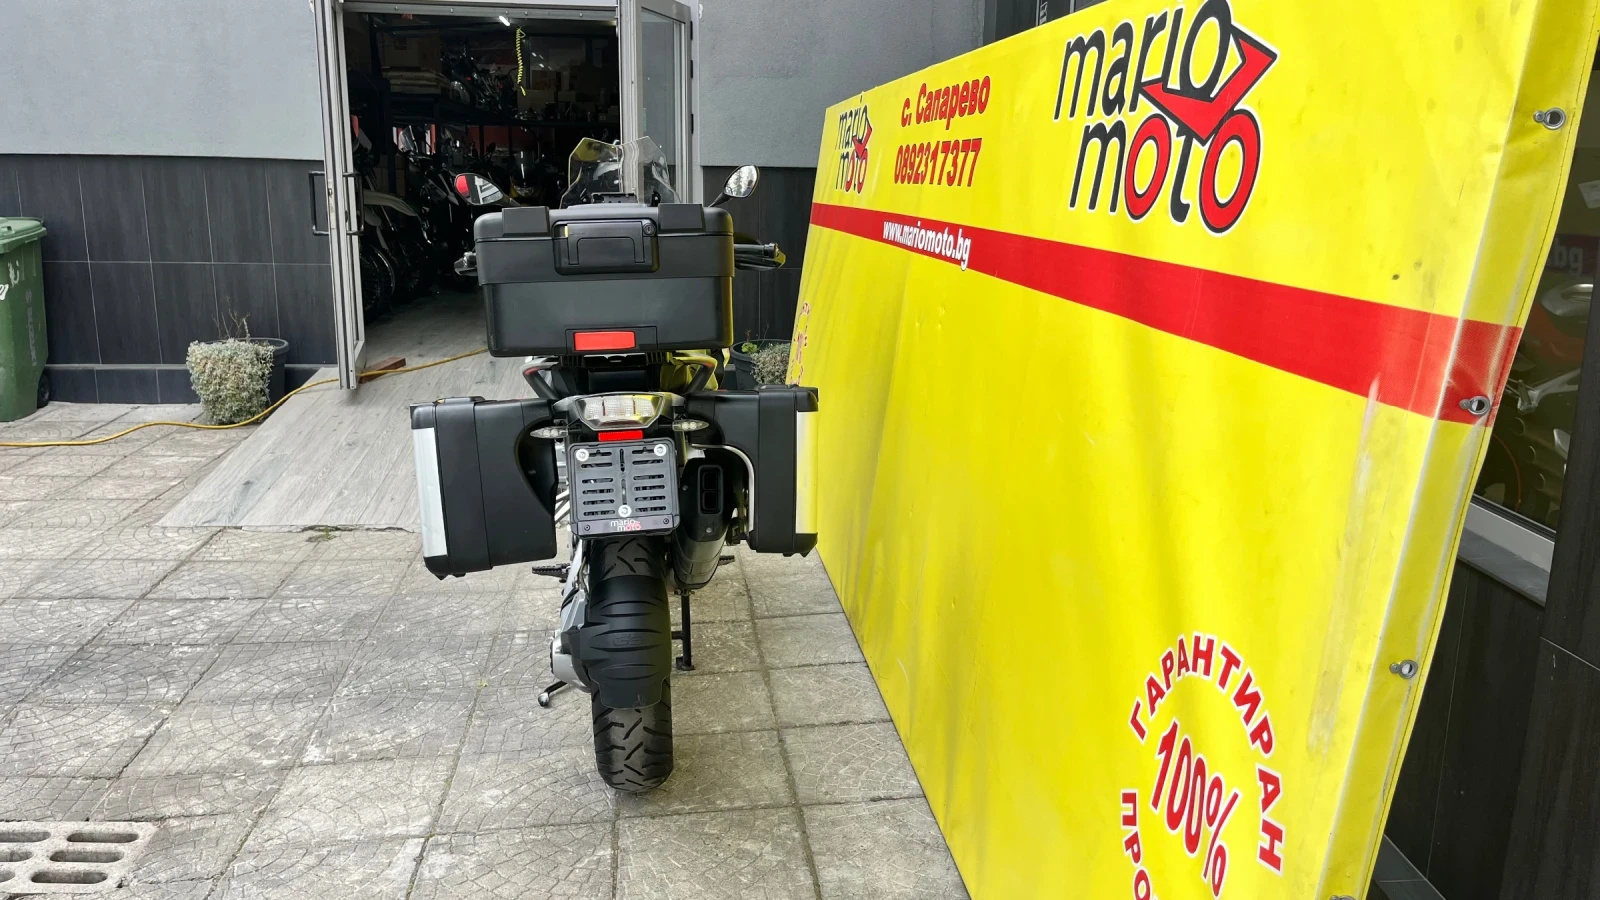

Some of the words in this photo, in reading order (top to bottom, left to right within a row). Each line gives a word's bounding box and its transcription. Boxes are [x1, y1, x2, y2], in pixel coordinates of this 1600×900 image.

[1054, 0, 1232, 120] mario
[835, 104, 868, 150] mario
[916, 76, 991, 130] Сапарево
[836, 148, 868, 194] moto
[894, 138, 982, 187] 0892317377
[1070, 108, 1261, 234] moto
[883, 221, 971, 271] www.mariomoto.bg
[1129, 634, 1284, 872] ГАРАНТИРАН
[1151, 720, 1240, 897] 100%
